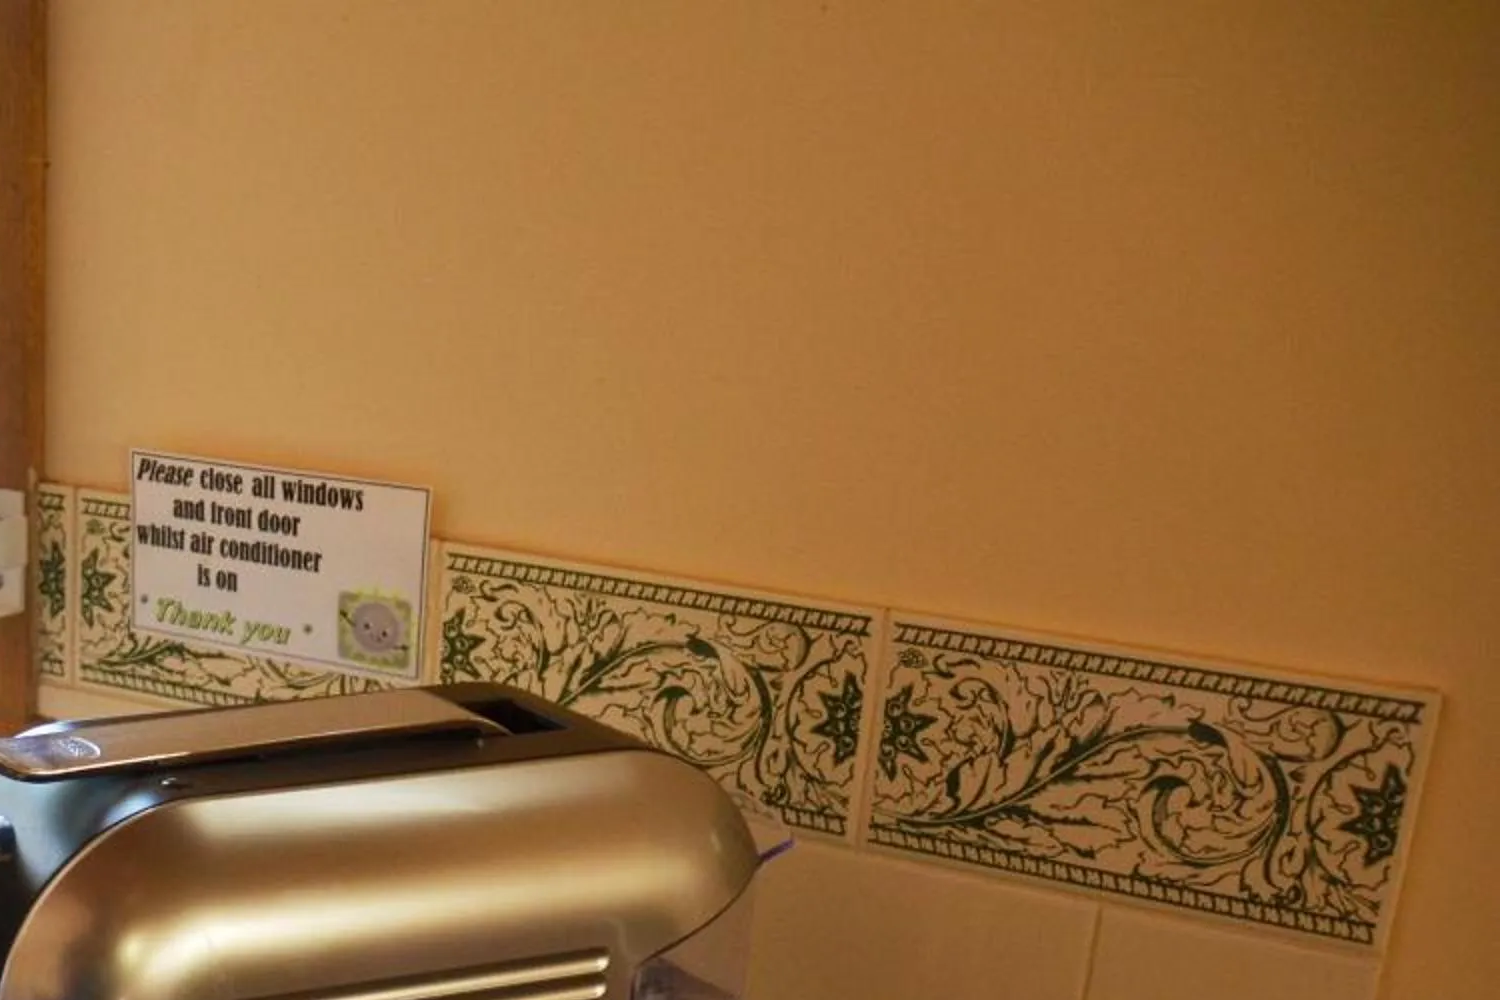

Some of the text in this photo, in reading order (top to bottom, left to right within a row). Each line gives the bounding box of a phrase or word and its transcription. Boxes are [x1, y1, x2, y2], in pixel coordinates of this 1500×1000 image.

[137, 457, 364, 512] Please close all windows
[173, 498, 301, 537] and front door
[137, 523, 323, 573] whilst air conditioner
[197, 563, 238, 593] is on
[155, 597, 292, 645] Thank you
